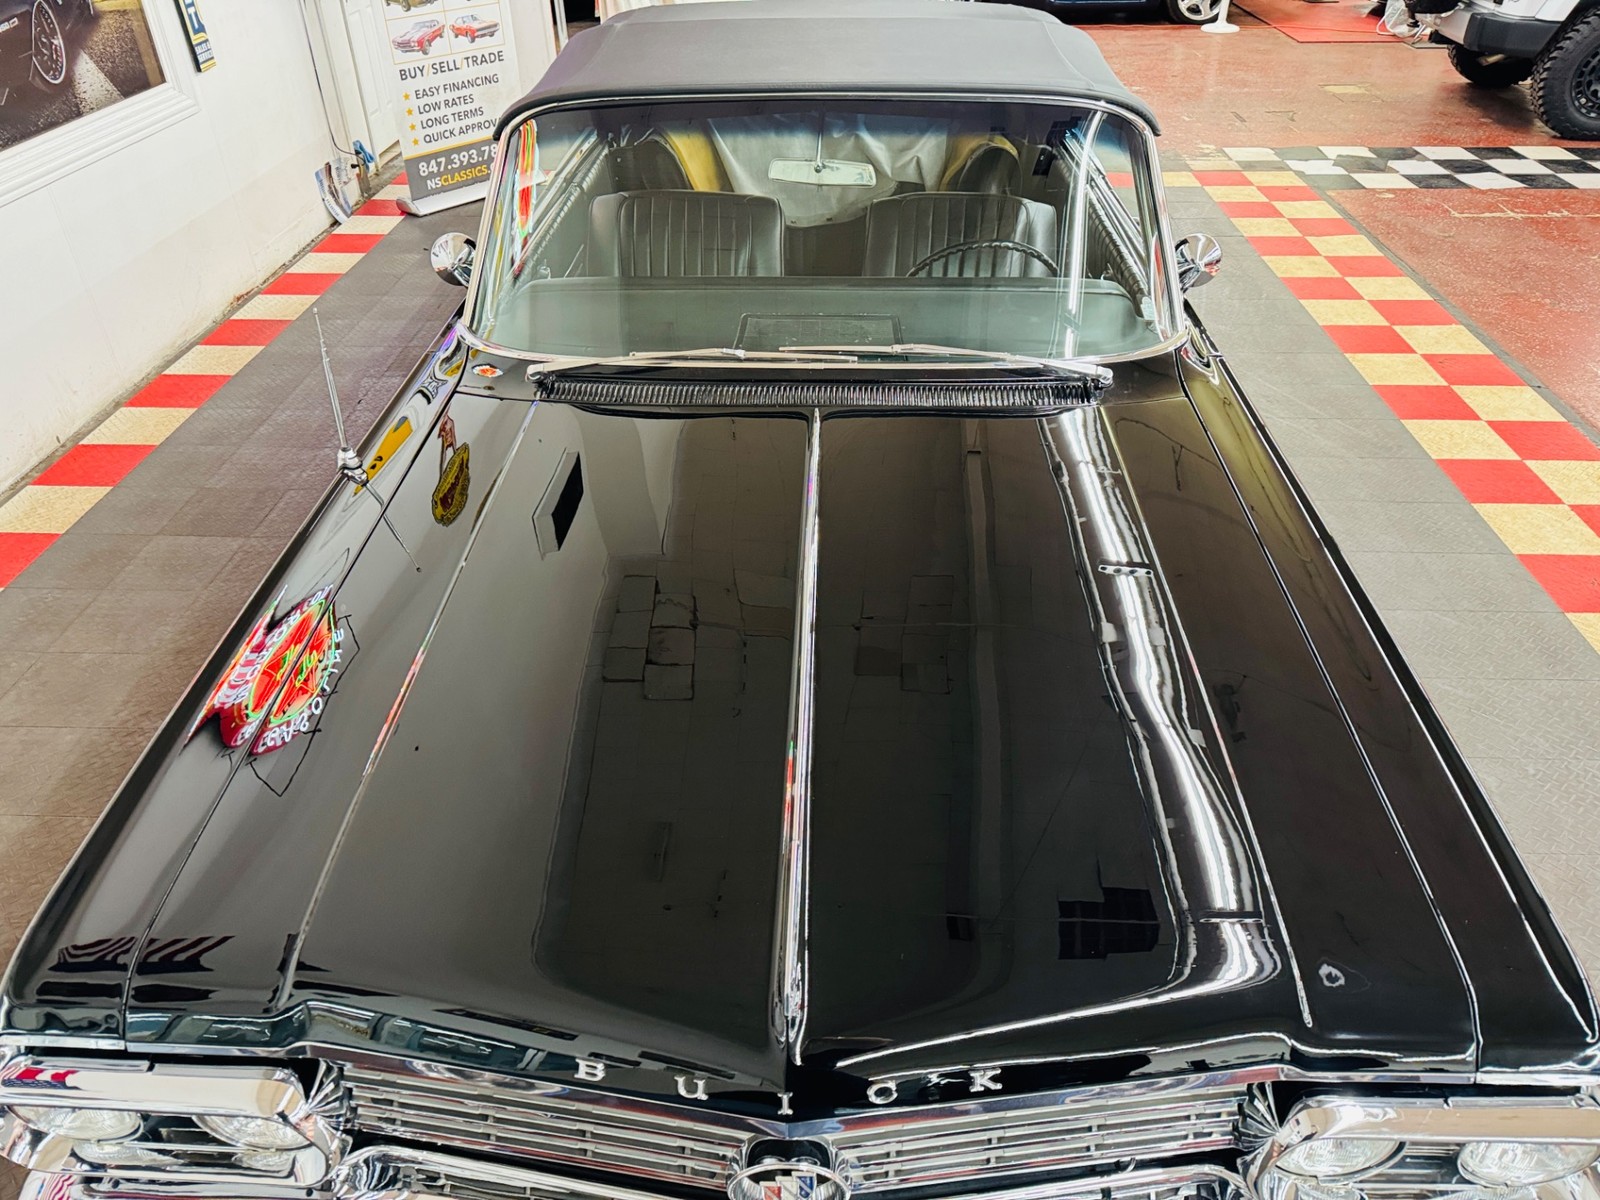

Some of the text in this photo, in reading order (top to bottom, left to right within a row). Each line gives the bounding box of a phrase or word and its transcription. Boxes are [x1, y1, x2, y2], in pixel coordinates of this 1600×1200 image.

[415, 73, 499, 100] EASY FINANCING
[417, 94, 475, 115] LOW RATES
[420, 107, 484, 130] LONG TERMS
[423, 129, 456, 144] QUICK
[574, 1057, 1003, 1116] BUICK
